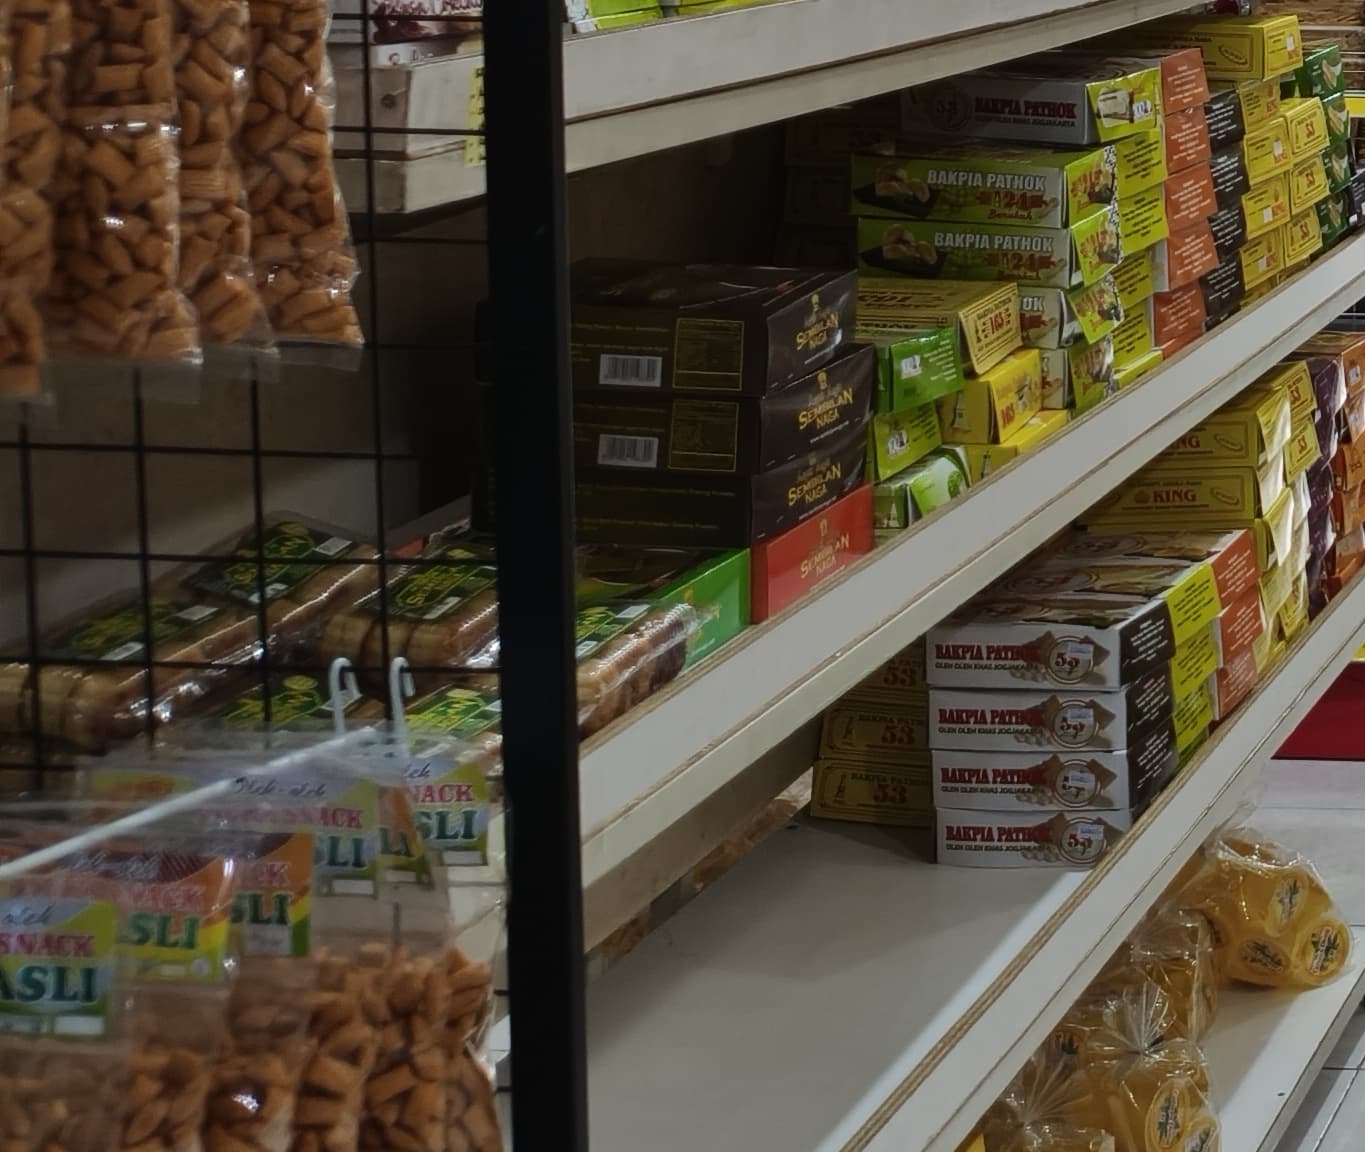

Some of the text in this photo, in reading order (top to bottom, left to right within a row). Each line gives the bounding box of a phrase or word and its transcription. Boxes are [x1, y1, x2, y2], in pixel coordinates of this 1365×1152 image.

[1023, 100, 1078, 120] PATHOK
[928, 169, 1046, 192] BAKPIA PATHOK
[934, 232, 1053, 252] BAKPIA PATHOK
[797, 388, 854, 430] SEMBILAN
[815, 410, 840, 431] NAGA
[787, 462, 841, 506] SEMBILAN
[804, 484, 828, 504] NAGA
[1152, 488, 1197, 503] KING
[935, 644, 983, 660] BAKPIA
[939, 709, 988, 725] BAKPIA
[941, 768, 989, 784] BAKPIA
[416, 809, 480, 841] SLI
[946, 825, 994, 842] BAKPIA
[127, 912, 200, 948] SLI
